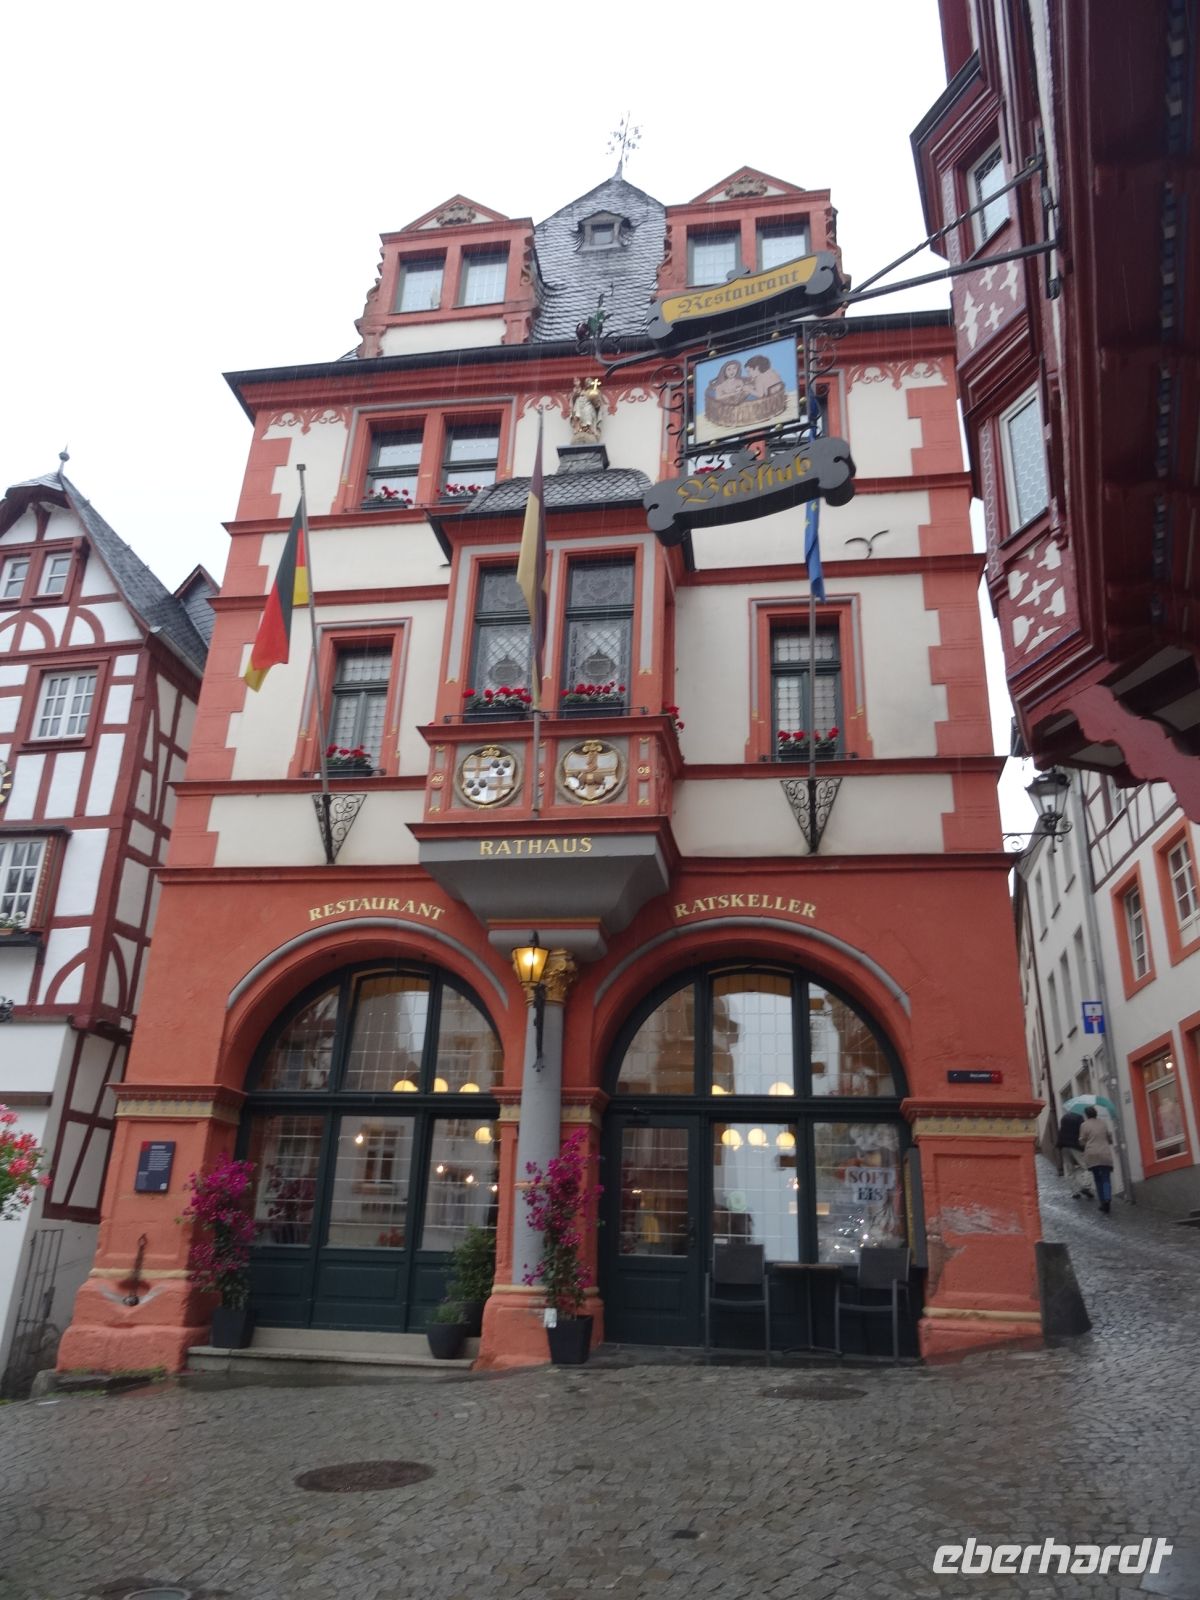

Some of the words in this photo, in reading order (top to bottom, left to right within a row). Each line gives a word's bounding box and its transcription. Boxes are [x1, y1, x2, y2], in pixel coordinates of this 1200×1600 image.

[479, 836, 593, 856] RATHAUS
[308, 896, 445, 922] RESTAURANT
[673, 893, 818, 919] RATSKELLER
[849, 1171, 890, 1184] SOFT
